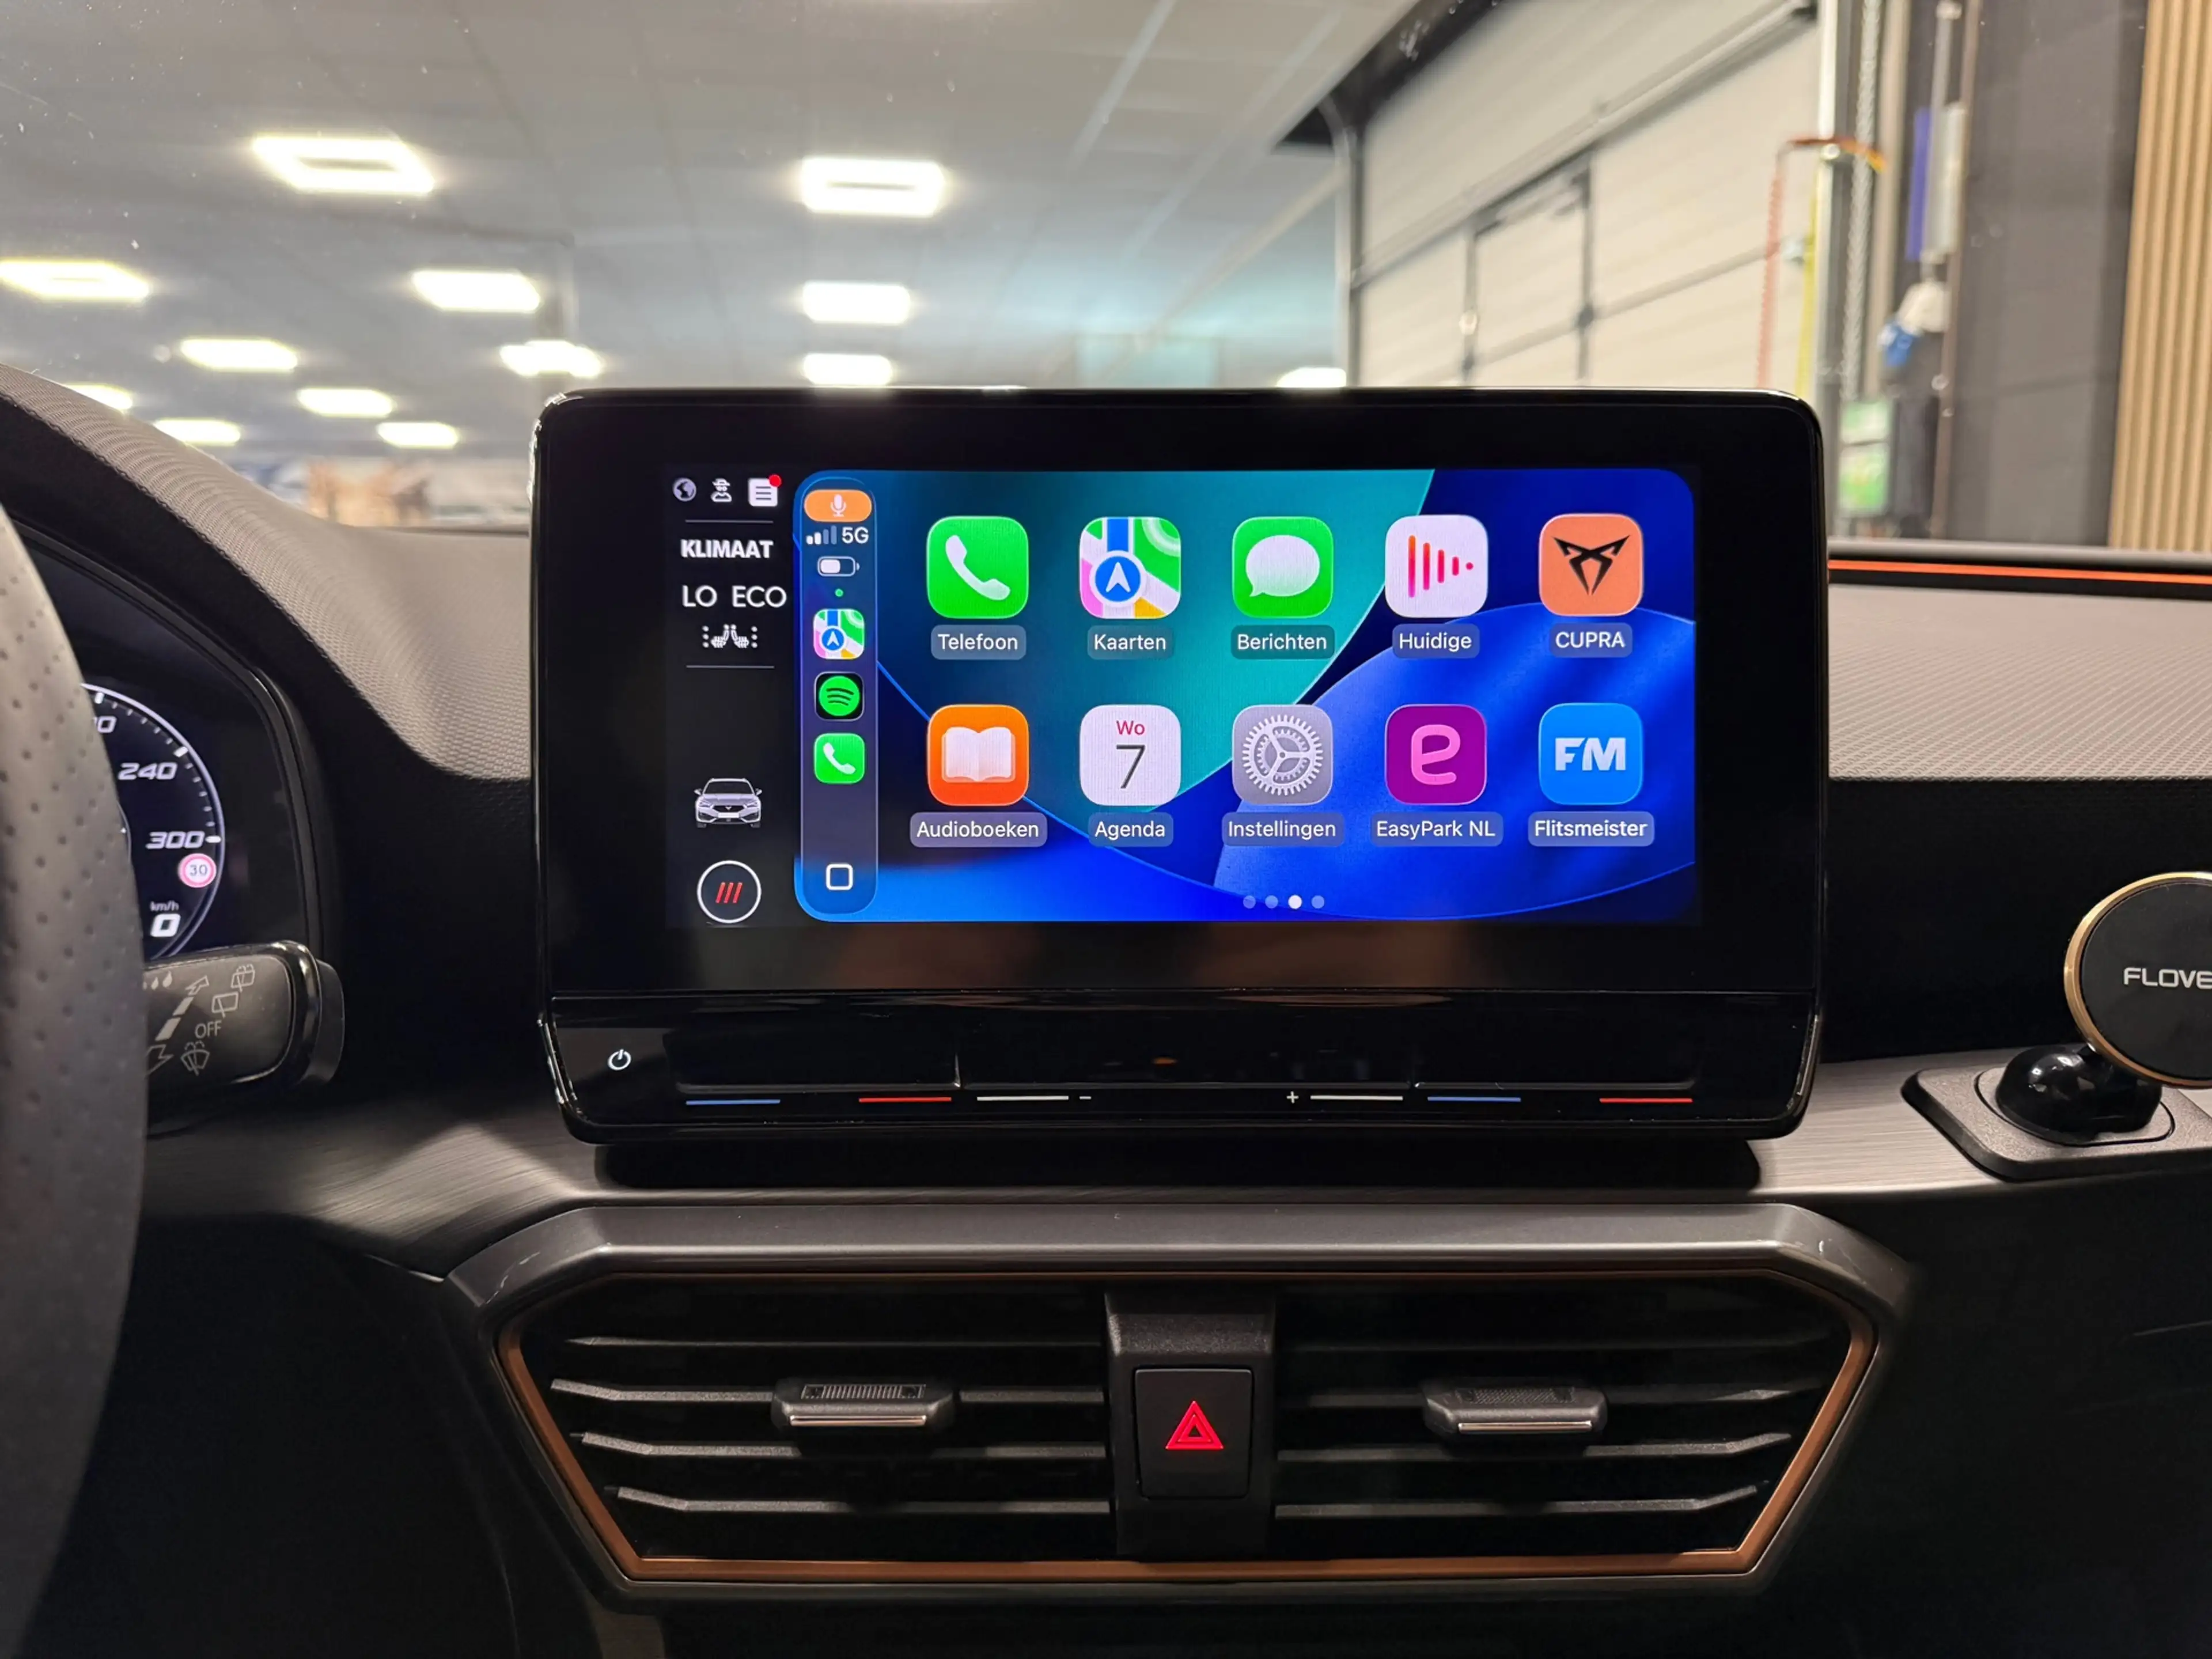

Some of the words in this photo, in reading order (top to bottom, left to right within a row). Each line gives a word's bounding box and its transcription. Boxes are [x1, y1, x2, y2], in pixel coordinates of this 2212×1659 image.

[841, 527, 869, 544] 5G
[680, 539, 774, 558] KLIMAAT
[682, 585, 718, 608] LO
[732, 585, 787, 608] ECO
[937, 633, 1018, 652] Telefoon
[1093, 634, 1167, 652] Kaarten
[1237, 633, 1327, 652] Berichten
[1399, 631, 1472, 654] Huidige
[1555, 631, 1626, 649] CUPRA
[92, 715, 118, 734] 0
[1116, 720, 1146, 736] Wo
[1411, 724, 1461, 786] e
[1555, 737, 1627, 771] FM
[117, 762, 178, 781] 240
[1115, 743, 1146, 790] 7
[916, 820, 1039, 838] Audioboeken
[1094, 820, 1166, 843] Agenda
[1228, 820, 1336, 843] Instellingen
[1376, 820, 1464, 842] EasyPark
[1469, 820, 1496, 838] NL
[1534, 819, 1647, 838] Flitsmeister
[145, 830, 206, 850] 300
[190, 864, 209, 877] 30
[150, 899, 180, 912] km/h
[150, 913, 182, 938] 0
[2123, 967, 2212, 990] FLOVE
[194, 1020, 222, 1039] OFF
